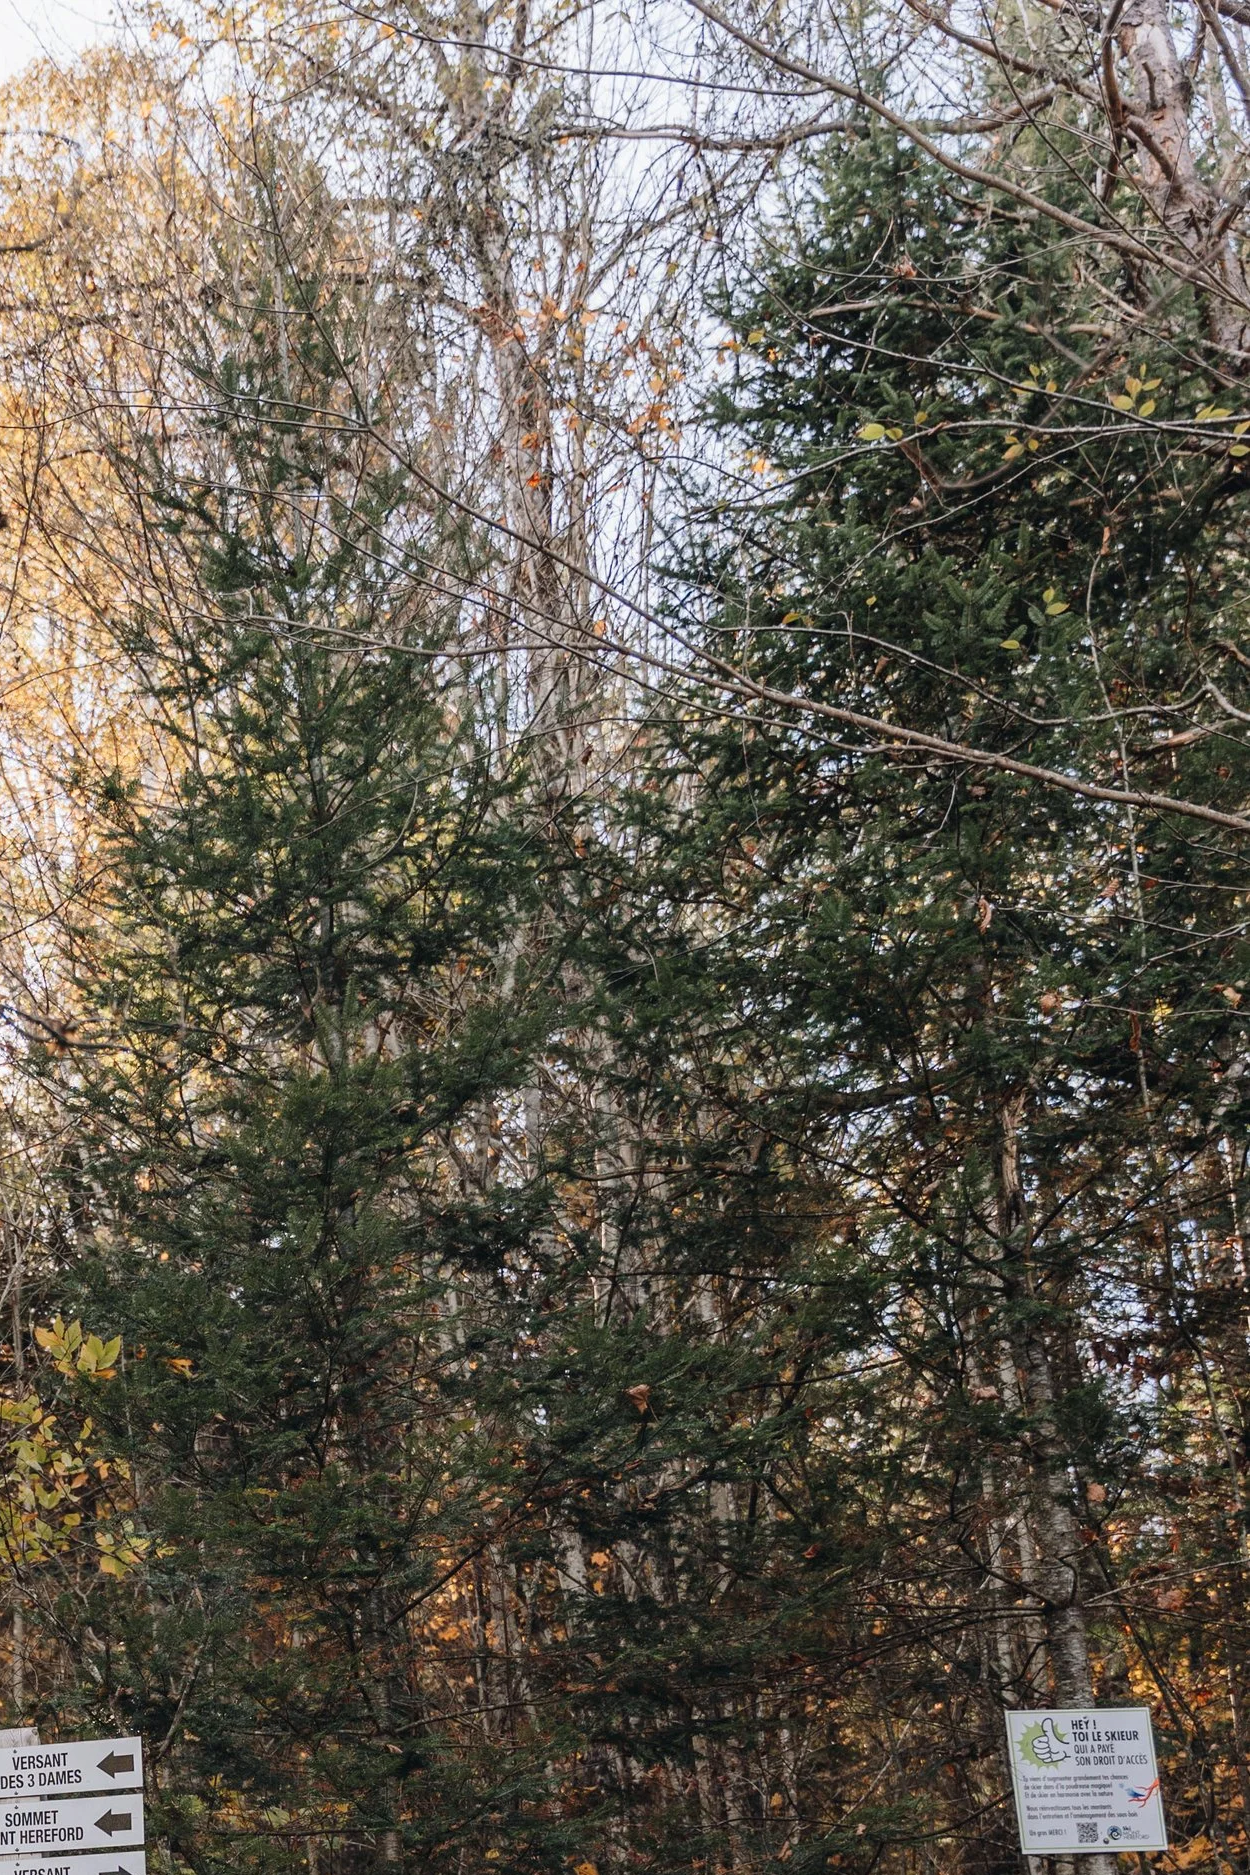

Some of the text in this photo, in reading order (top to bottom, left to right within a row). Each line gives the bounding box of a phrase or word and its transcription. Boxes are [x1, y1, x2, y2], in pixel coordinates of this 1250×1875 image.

[1071, 1719, 1089, 1729] HEY
[1072, 1731, 1139, 1742] TOI LE SKIEUR
[1074, 1744, 1088, 1753] QUI
[1090, 1744, 1095, 1753] A
[12, 1753, 68, 1770] VERSANT
[1076, 1757, 1091, 1766] SON
[1093, 1755, 1116, 1765] DROIT
[1, 1770, 81, 1789] DES 3 DAMES
[5, 1811, 58, 1827] SOMMET
[20, 1827, 83, 1844] HEREFORD
